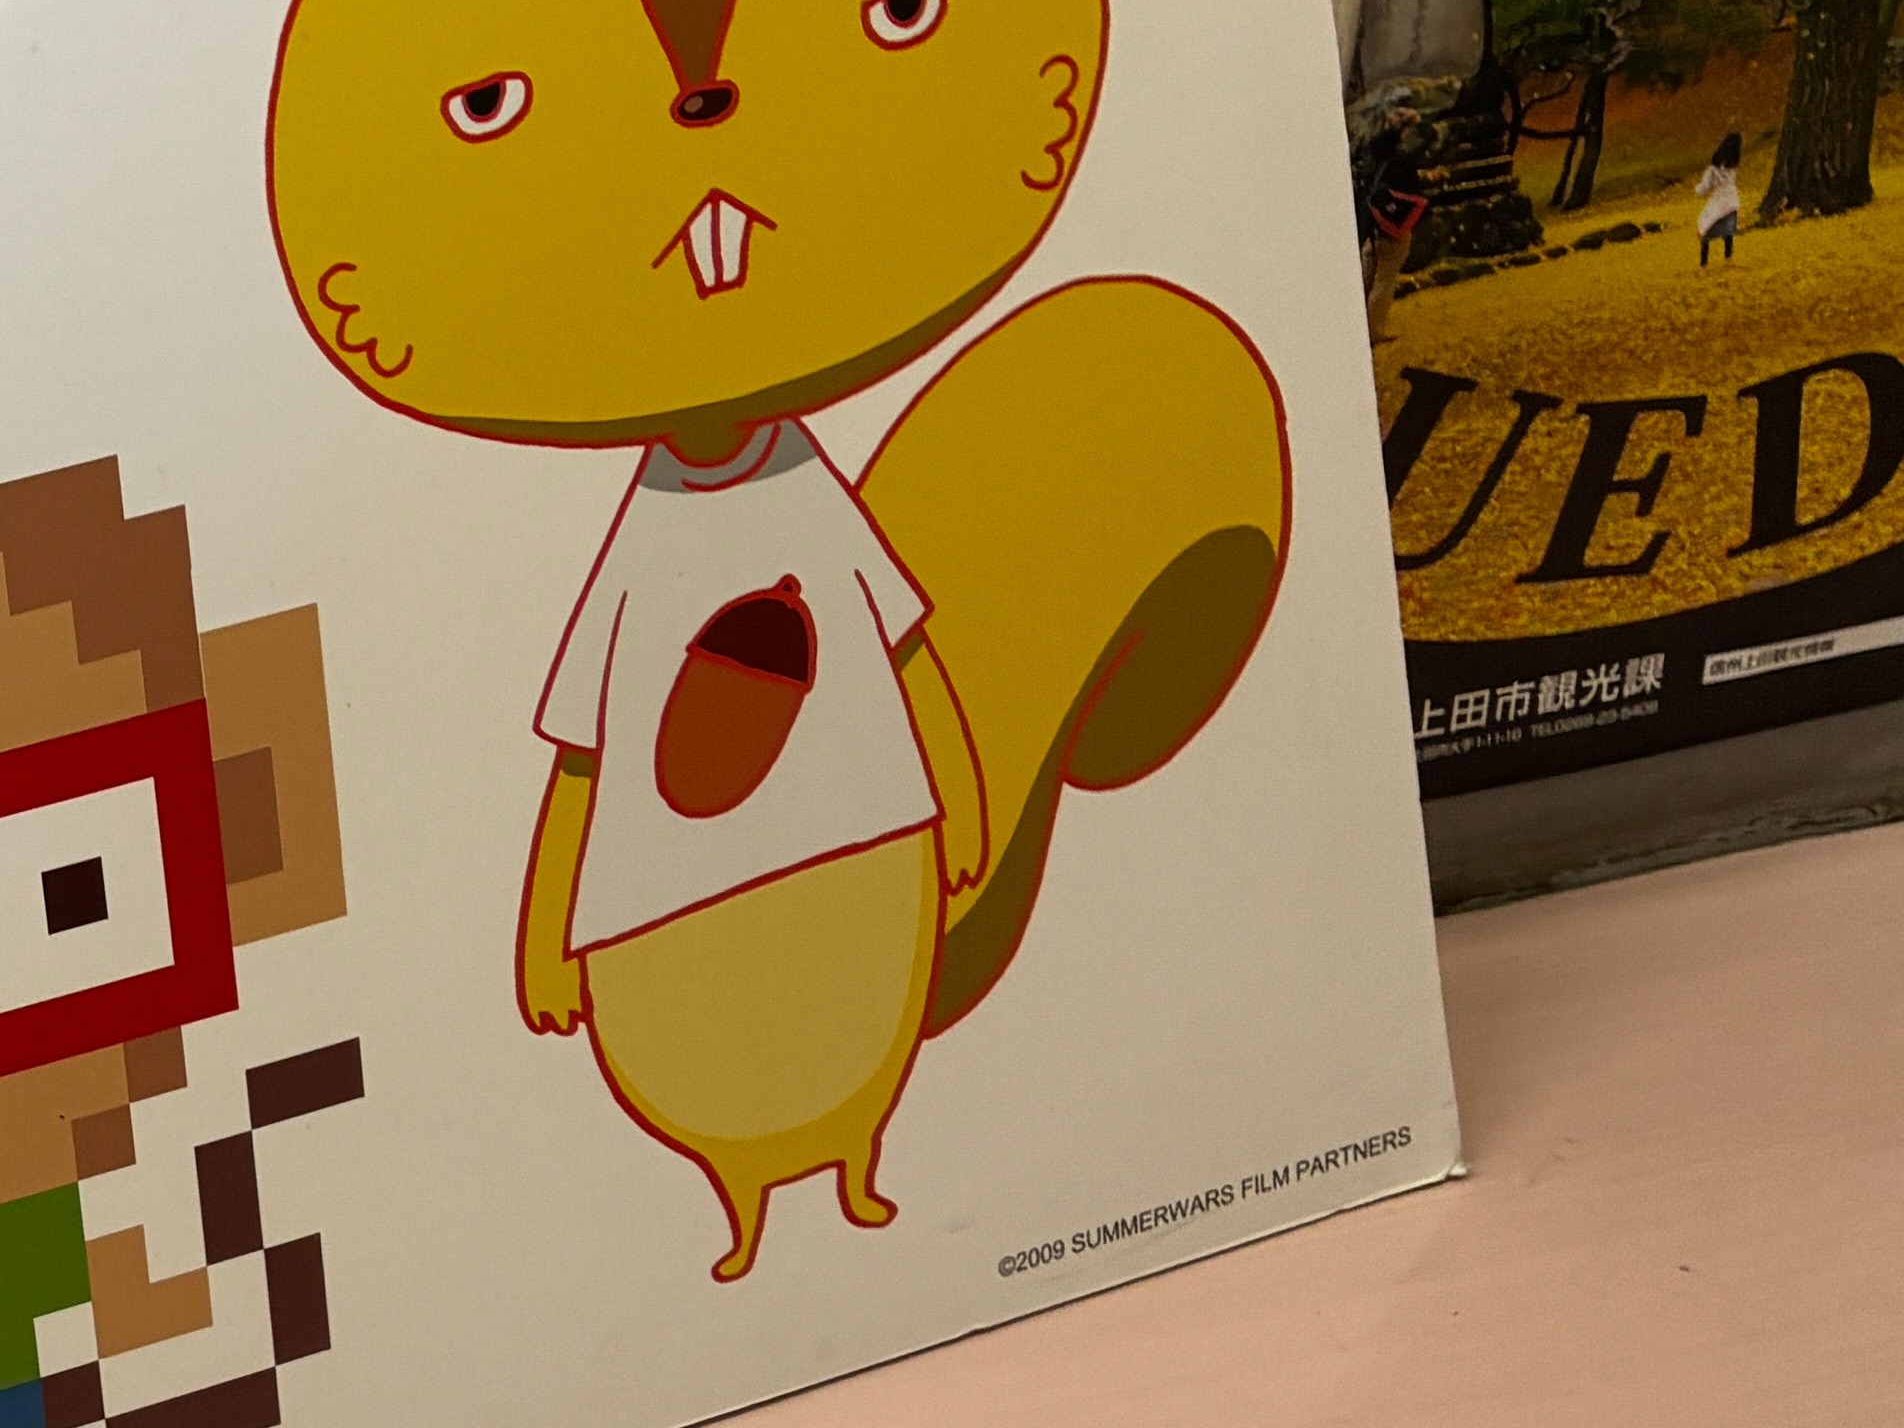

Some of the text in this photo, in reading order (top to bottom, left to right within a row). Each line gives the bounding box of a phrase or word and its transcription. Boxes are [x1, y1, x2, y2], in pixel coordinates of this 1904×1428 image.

[1413, 652, 1666, 741] 上田市観光課
[997, 1125, 1413, 1279] ©2009 SUMMERWARS FILM PARTNERS
